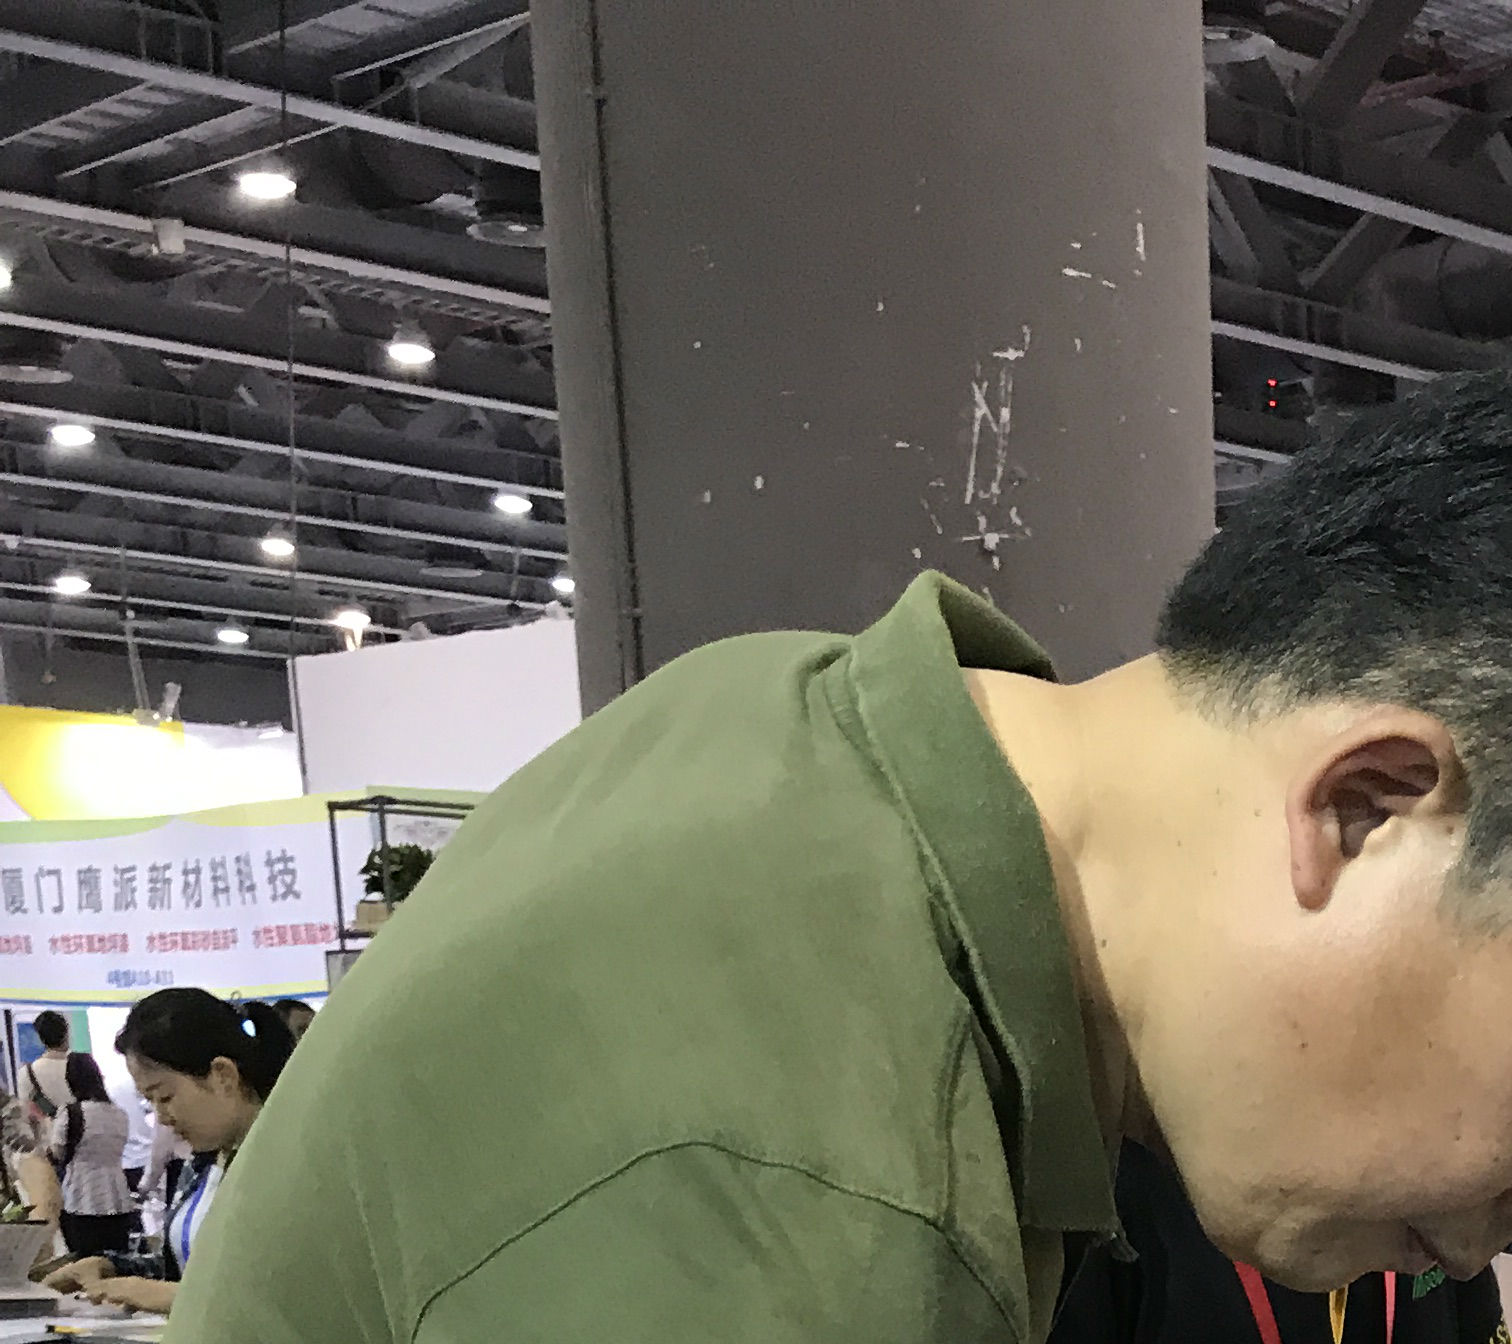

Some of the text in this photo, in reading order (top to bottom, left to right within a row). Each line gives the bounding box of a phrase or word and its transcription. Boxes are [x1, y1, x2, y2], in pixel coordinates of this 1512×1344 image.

[1, 848, 302, 915] 厦门鹰派新材料科技
